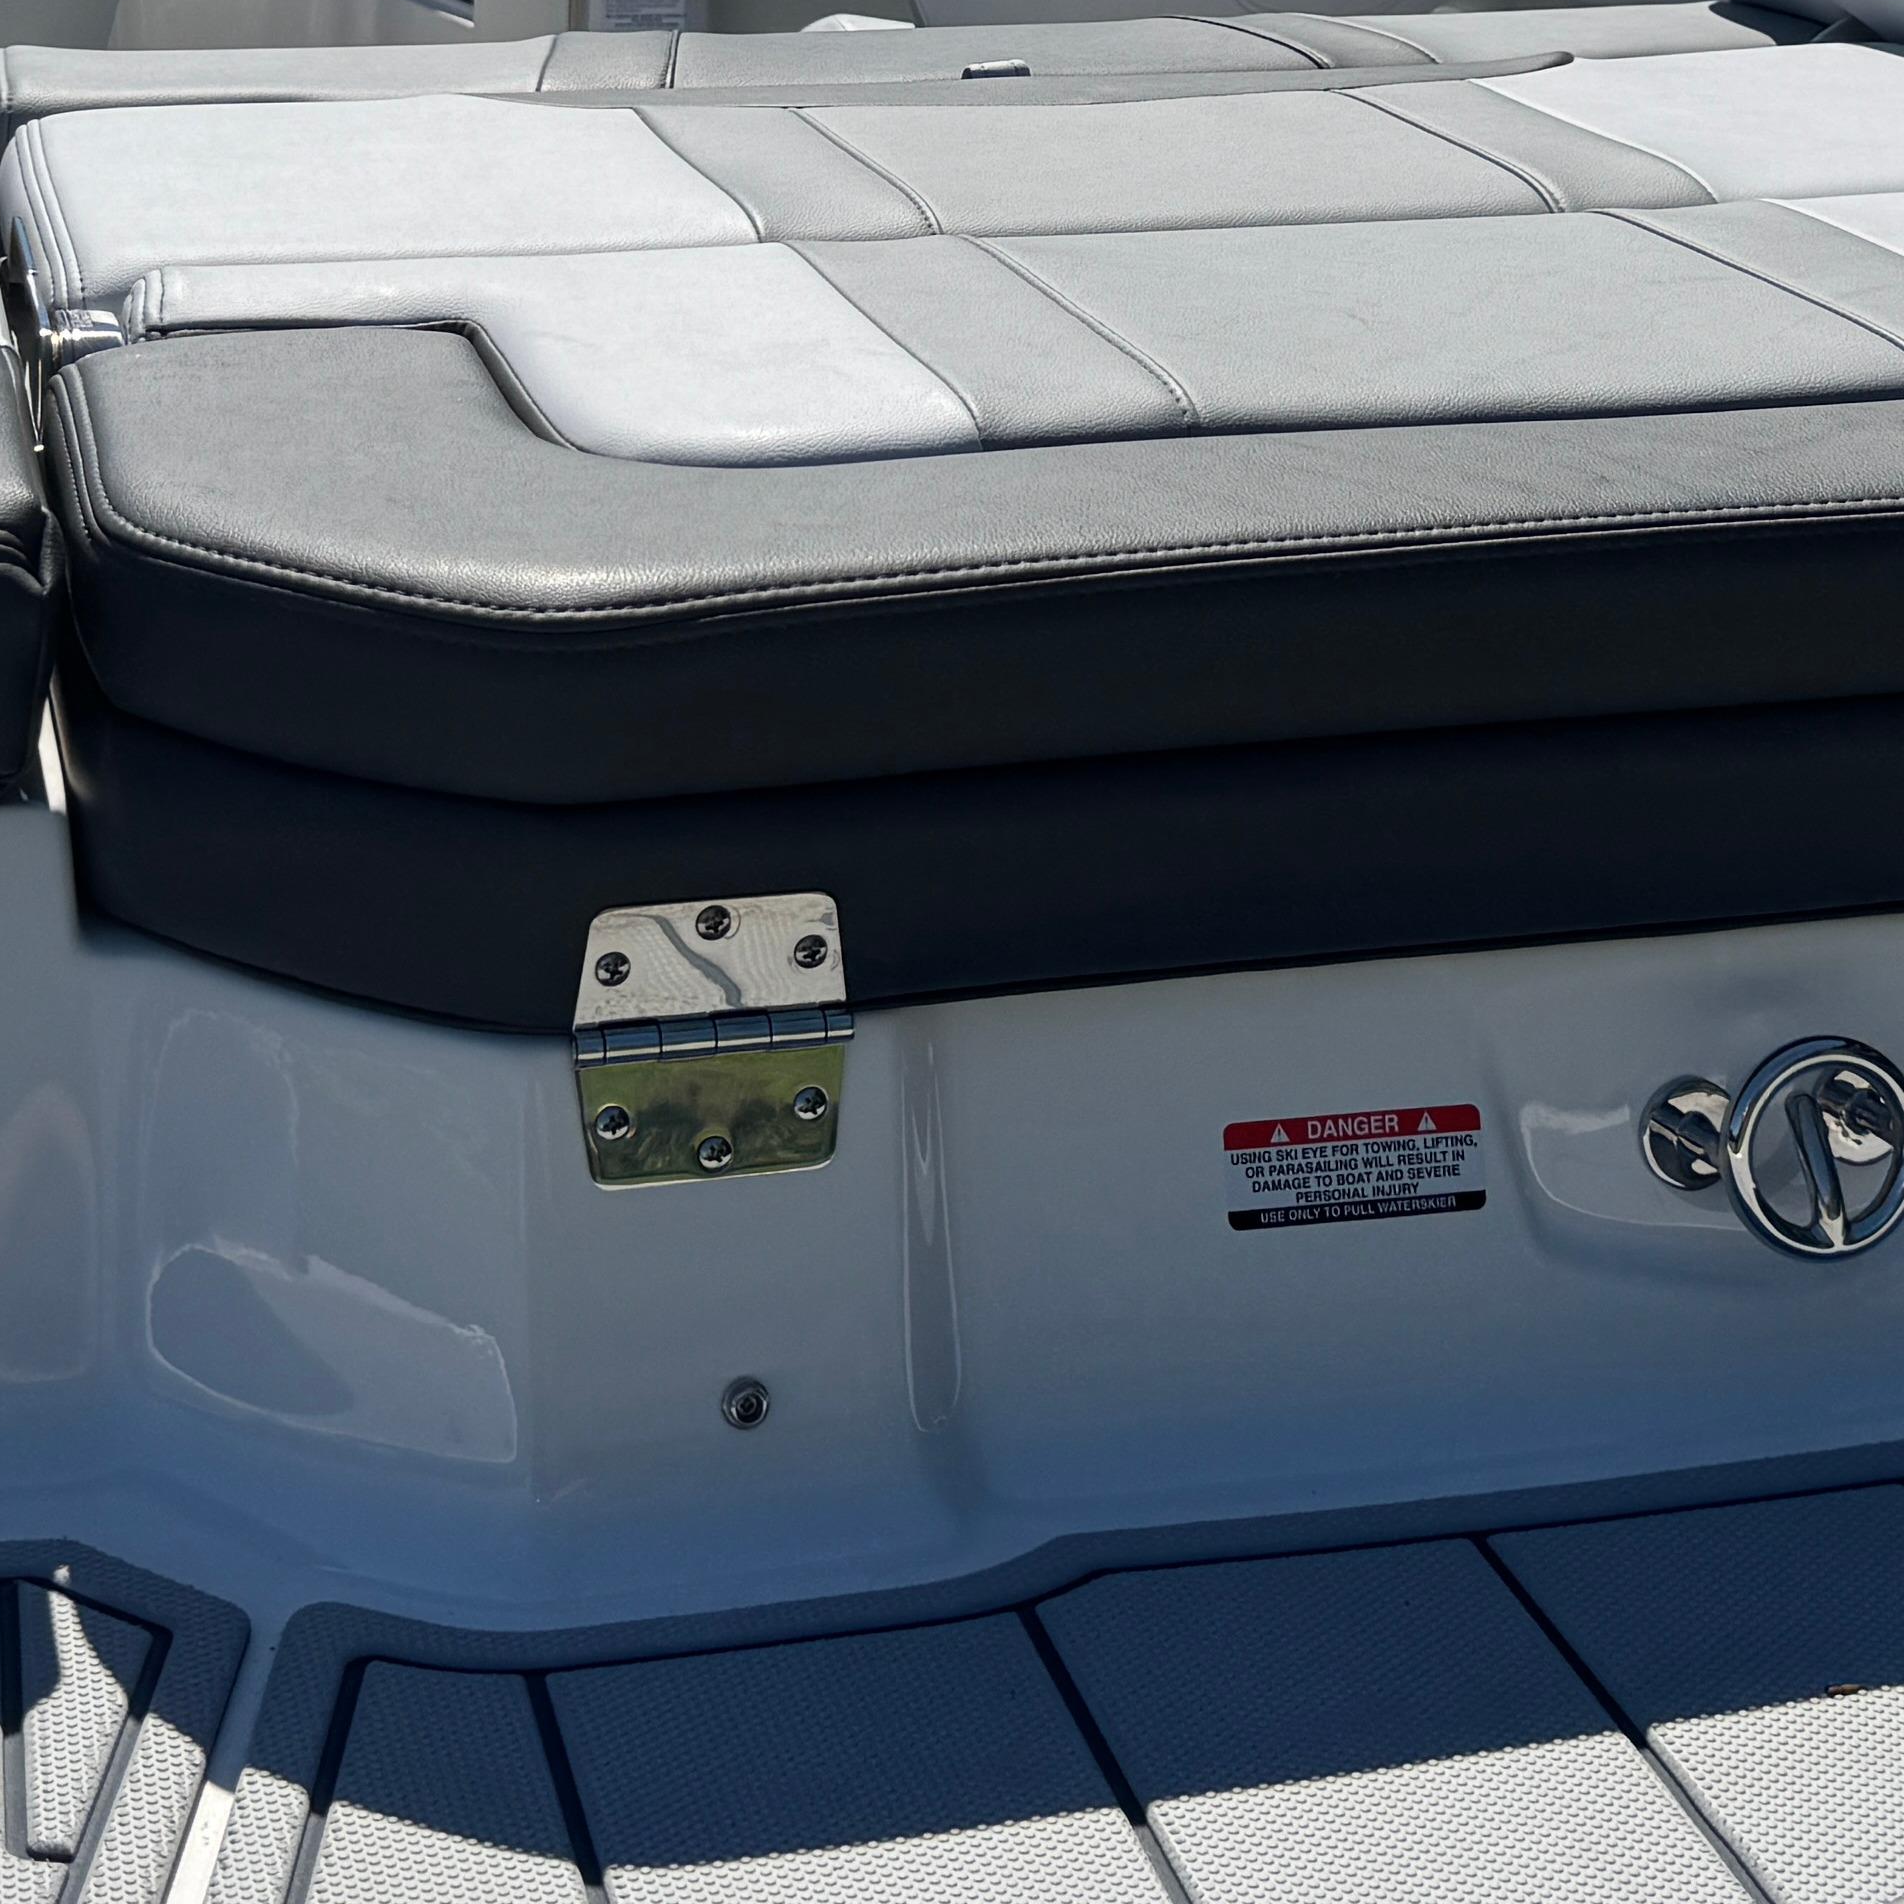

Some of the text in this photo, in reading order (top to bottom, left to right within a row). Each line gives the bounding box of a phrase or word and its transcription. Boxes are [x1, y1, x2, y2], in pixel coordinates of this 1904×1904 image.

[1307, 1114, 1399, 1139] DANGER
[1231, 1150, 1272, 1165] USING
[1276, 1148, 1298, 1162] SKI
[1302, 1147, 1328, 1161] EYE
[1331, 1143, 1359, 1158] FOR
[1246, 1149, 1465, 1179] OR PARASAILING WILL RESULT IN
[1252, 1163, 1461, 1193] DAMAGE TO BOAT AND SEVERE
[1296, 1182, 1419, 1203] PERSONAL INJURY
[1261, 1195, 1457, 1224] USE ONLY TO PULL WATERSKIER
